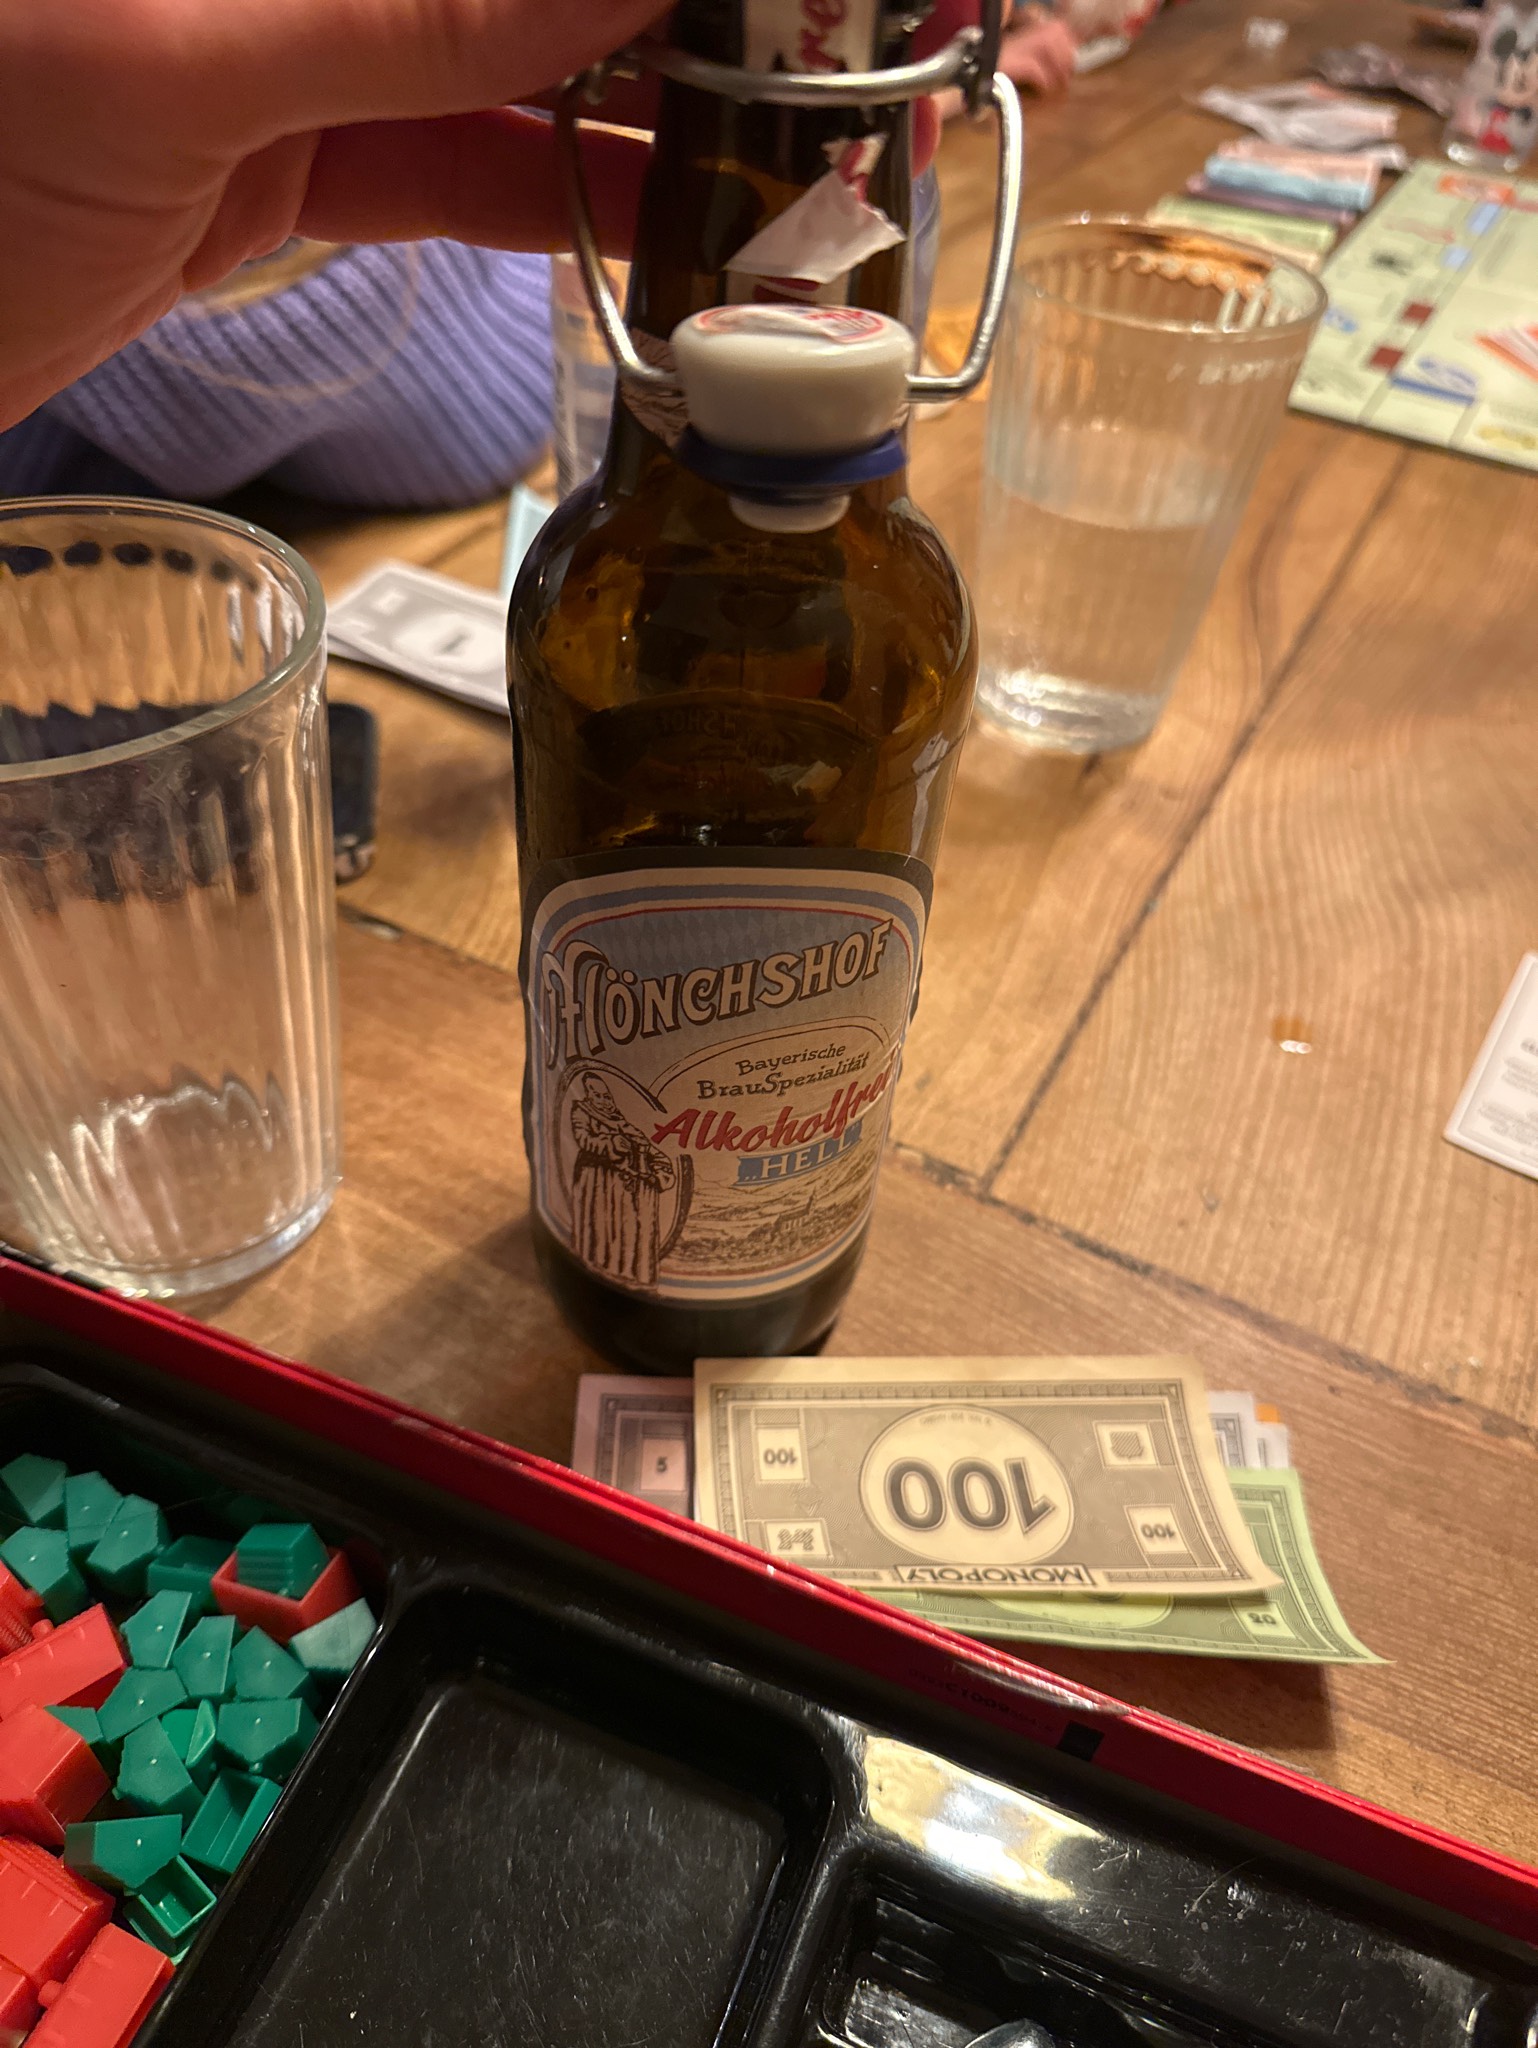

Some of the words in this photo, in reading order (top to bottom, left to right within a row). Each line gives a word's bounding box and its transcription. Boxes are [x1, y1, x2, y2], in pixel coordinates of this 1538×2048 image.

[541, 919, 893, 1070] MÖNCHSHOF
[735, 1043, 847, 1076] Bayerische
[697, 1052, 870, 1099] BrauSpezialität
[656, 1456, 668, 1473] 5
[764, 1448, 797, 1465] 100
[883, 1456, 1056, 1535] 100
[1140, 1523, 1176, 1539] 100
[906, 1567, 1085, 1582] MONOPOLY
